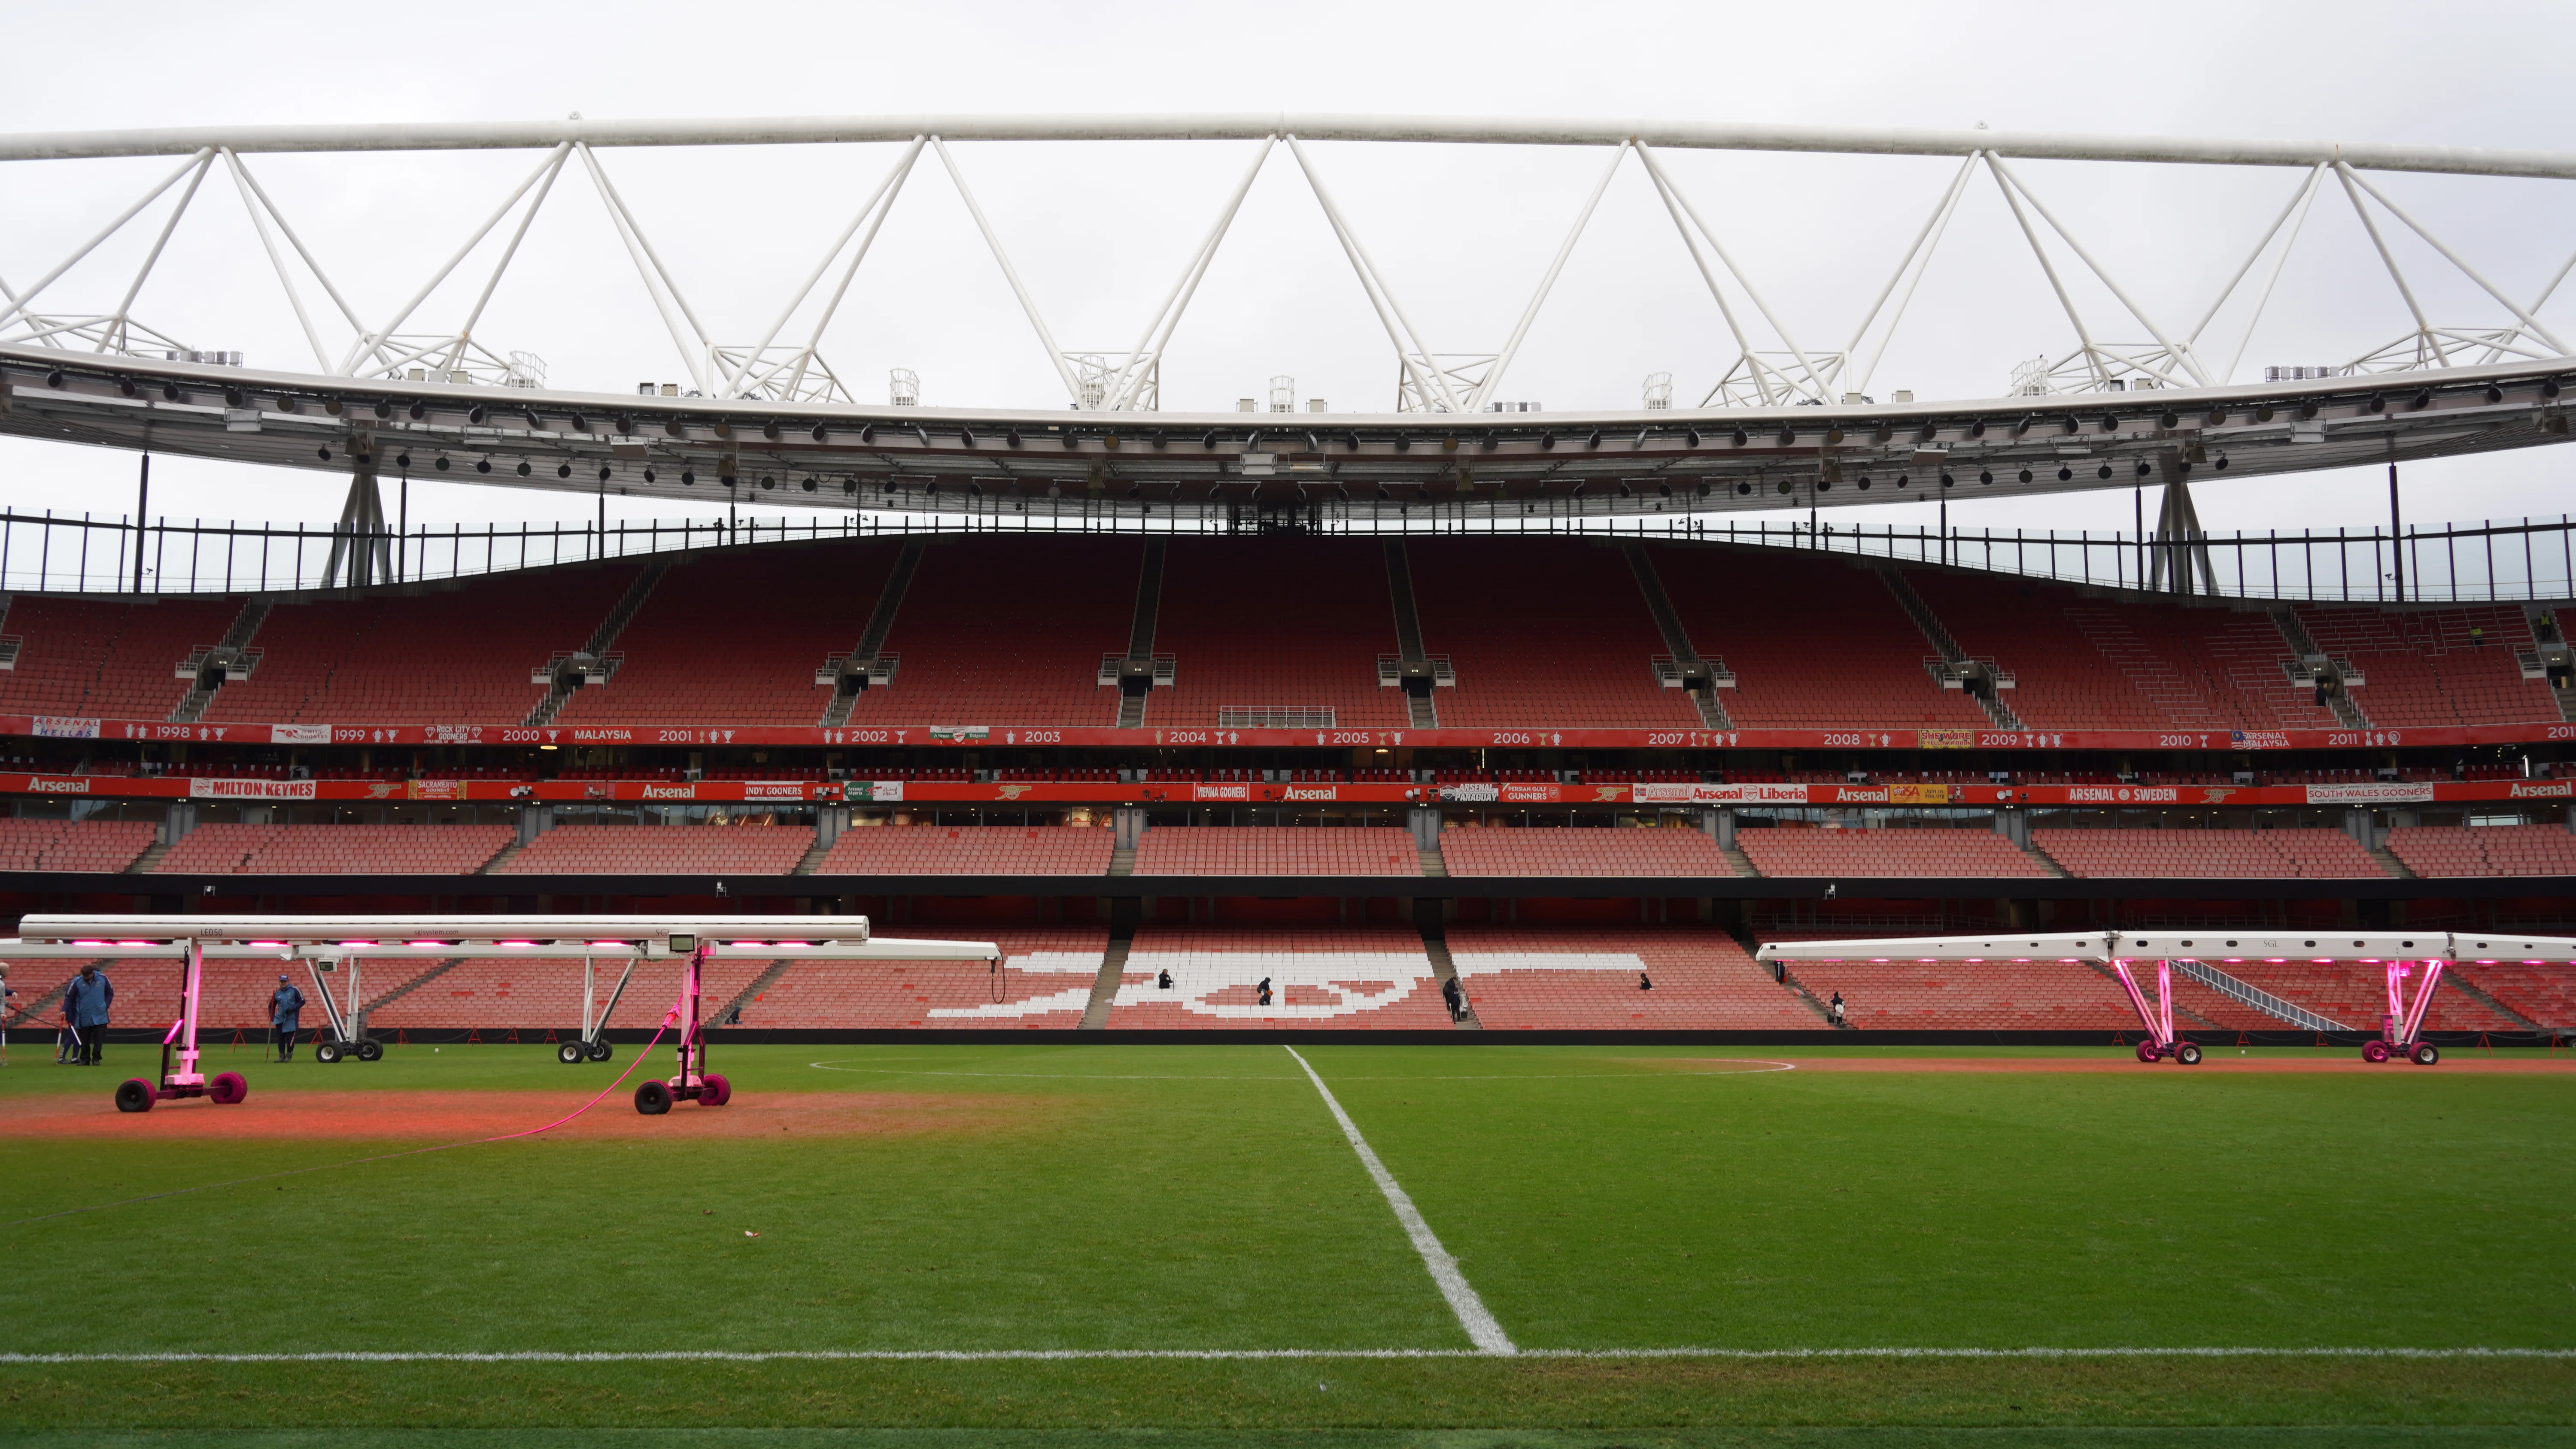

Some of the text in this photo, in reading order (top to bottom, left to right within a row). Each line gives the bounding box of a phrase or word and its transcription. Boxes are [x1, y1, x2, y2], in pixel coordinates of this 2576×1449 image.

[34, 717, 98, 727] ARSENAL
[39, 728, 92, 737] HELLAS
[157, 726, 190, 738] 1998
[335, 729, 365, 741] 1999
[503, 730, 539, 741] 2000
[574, 730, 632, 740] MALAYSIA
[659, 731, 692, 742] 2001
[851, 731, 887, 742] 2002
[1025, 731, 1060, 743] 2003
[1170, 732, 1206, 743] 2004
[1333, 732, 1369, 743] 2005
[1493, 733, 1530, 744] 2006
[1649, 733, 1684, 744] 2007
[1824, 734, 1860, 745] 2008
[1982, 734, 2017, 746] 2009
[2160, 735, 2191, 746] 2010
[2243, 739, 2290, 747] MALAYSIA
[2328, 734, 2357, 745] 2011
[27, 777, 89, 793] Arsenal
[213, 782, 313, 797] MILTON KEYNES
[1458, 783, 1494, 792] ARSENAL
[2509, 781, 2572, 797] Arsenal
[642, 784, 695, 798] Arsenal
[746, 787, 802, 795] INDY GOONERS
[1197, 786, 1245, 798] VIENNA GOONERS
[1284, 786, 1336, 800] Arsenal
[1648, 785, 1689, 797] Arsenal
[1692, 787, 1807, 800] Arsenal Liberia
[1836, 788, 1888, 801] Arsenal
[2069, 788, 2177, 801] ARSENAL SWEDEN
[2382, 788, 2432, 796] GOONERS
[1455, 792, 1497, 802] PARAGUAY
